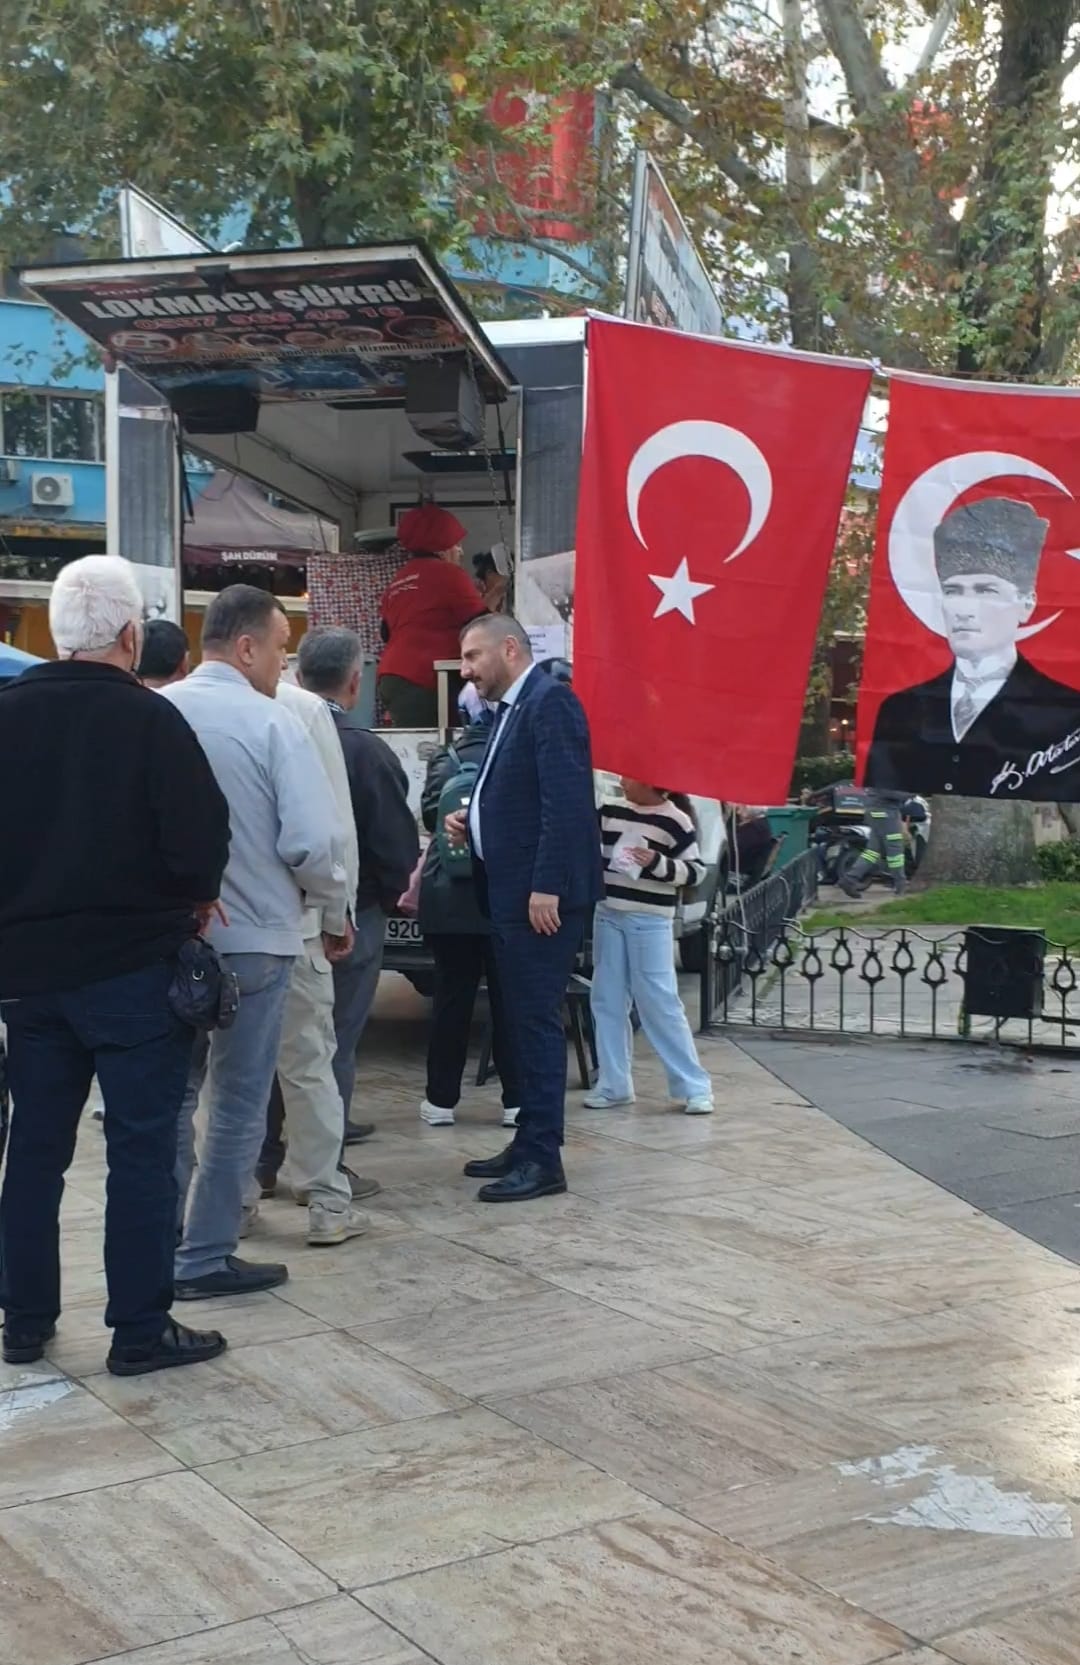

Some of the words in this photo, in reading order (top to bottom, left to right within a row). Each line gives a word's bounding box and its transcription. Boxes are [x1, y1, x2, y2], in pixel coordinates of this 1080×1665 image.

[82, 291, 273, 319] LOKMACI
[273, 279, 422, 312] ŞÜKRÜ
[221, 551, 241, 562] ŞAH
[242, 550, 278, 561] DÜRÜM
